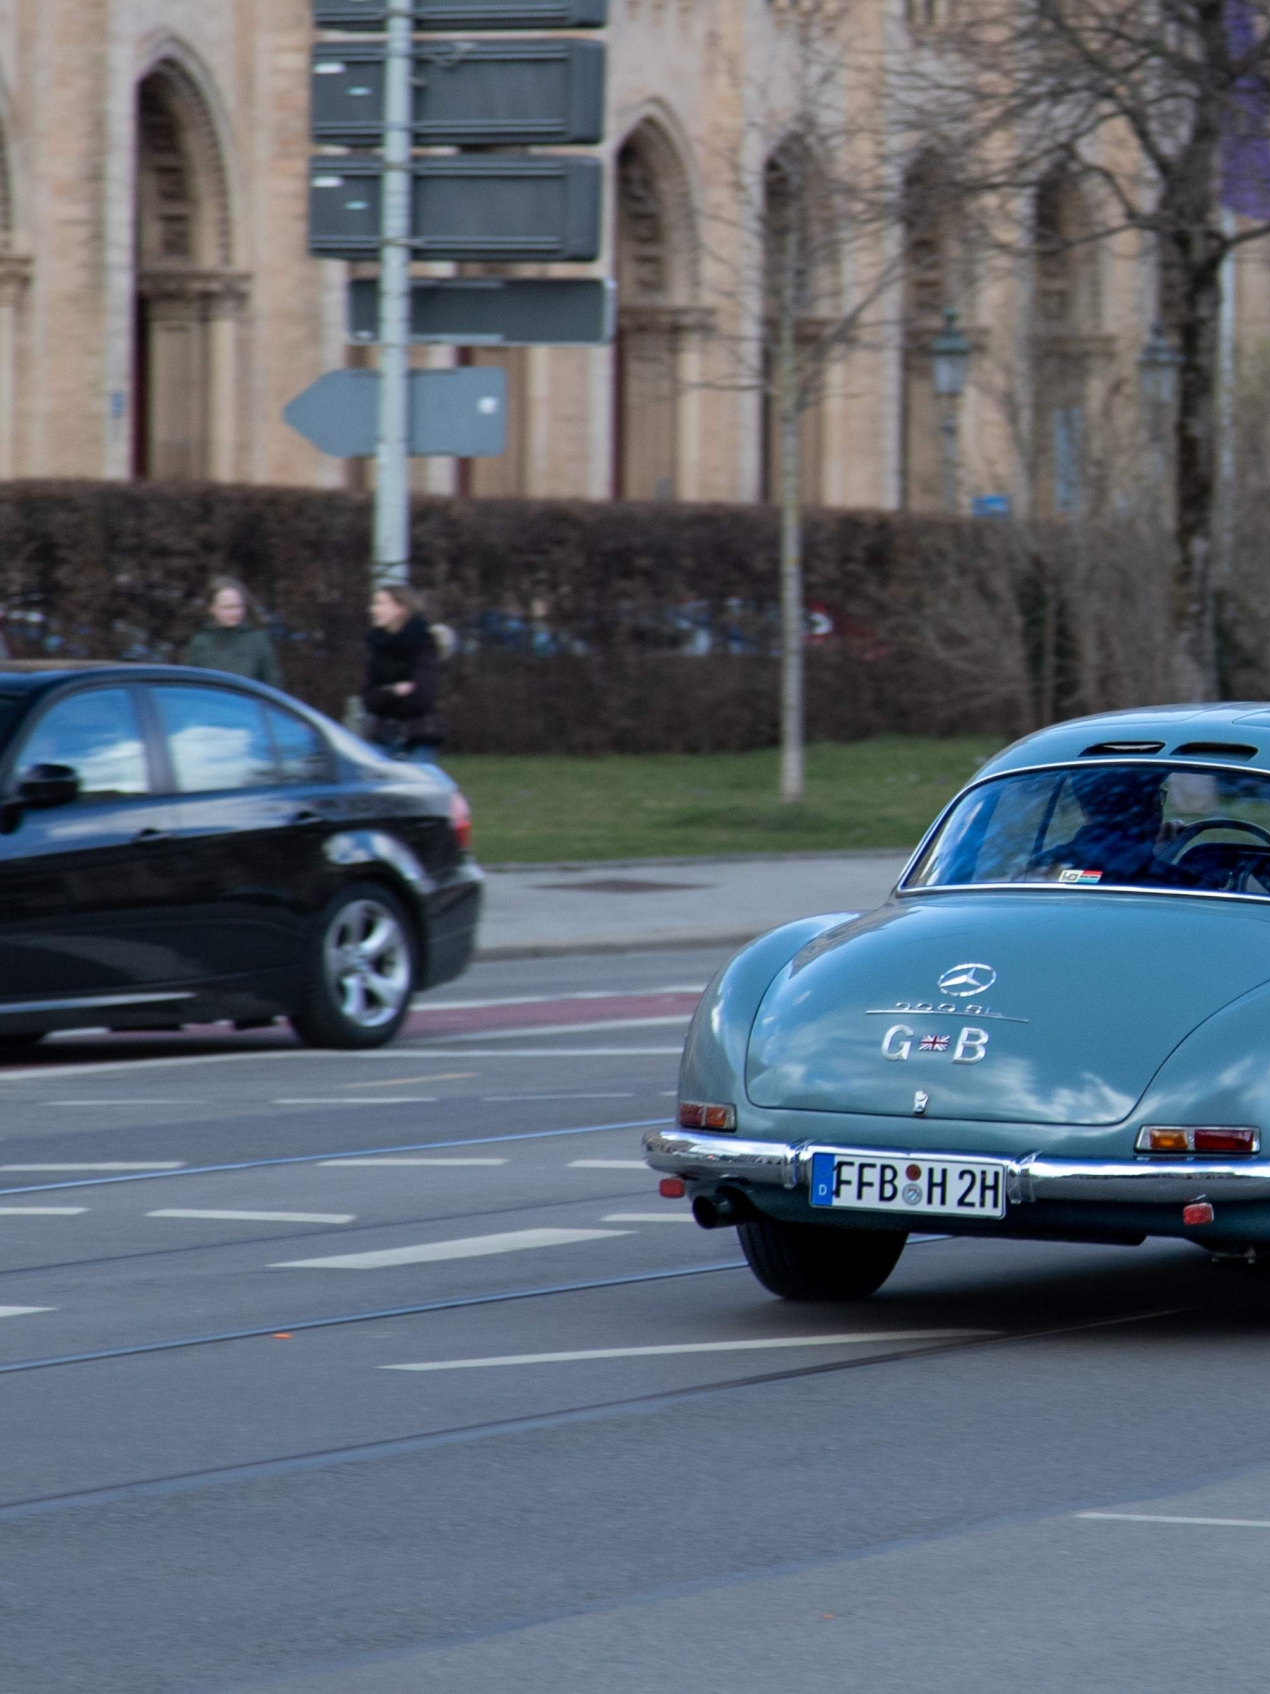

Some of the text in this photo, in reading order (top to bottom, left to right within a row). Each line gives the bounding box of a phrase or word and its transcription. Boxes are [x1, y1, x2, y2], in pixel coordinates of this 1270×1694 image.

[881, 1024, 989, 1065] G B
[818, 1183, 827, 1196] D
[833, 1161, 1000, 1208] FFB H 2H
